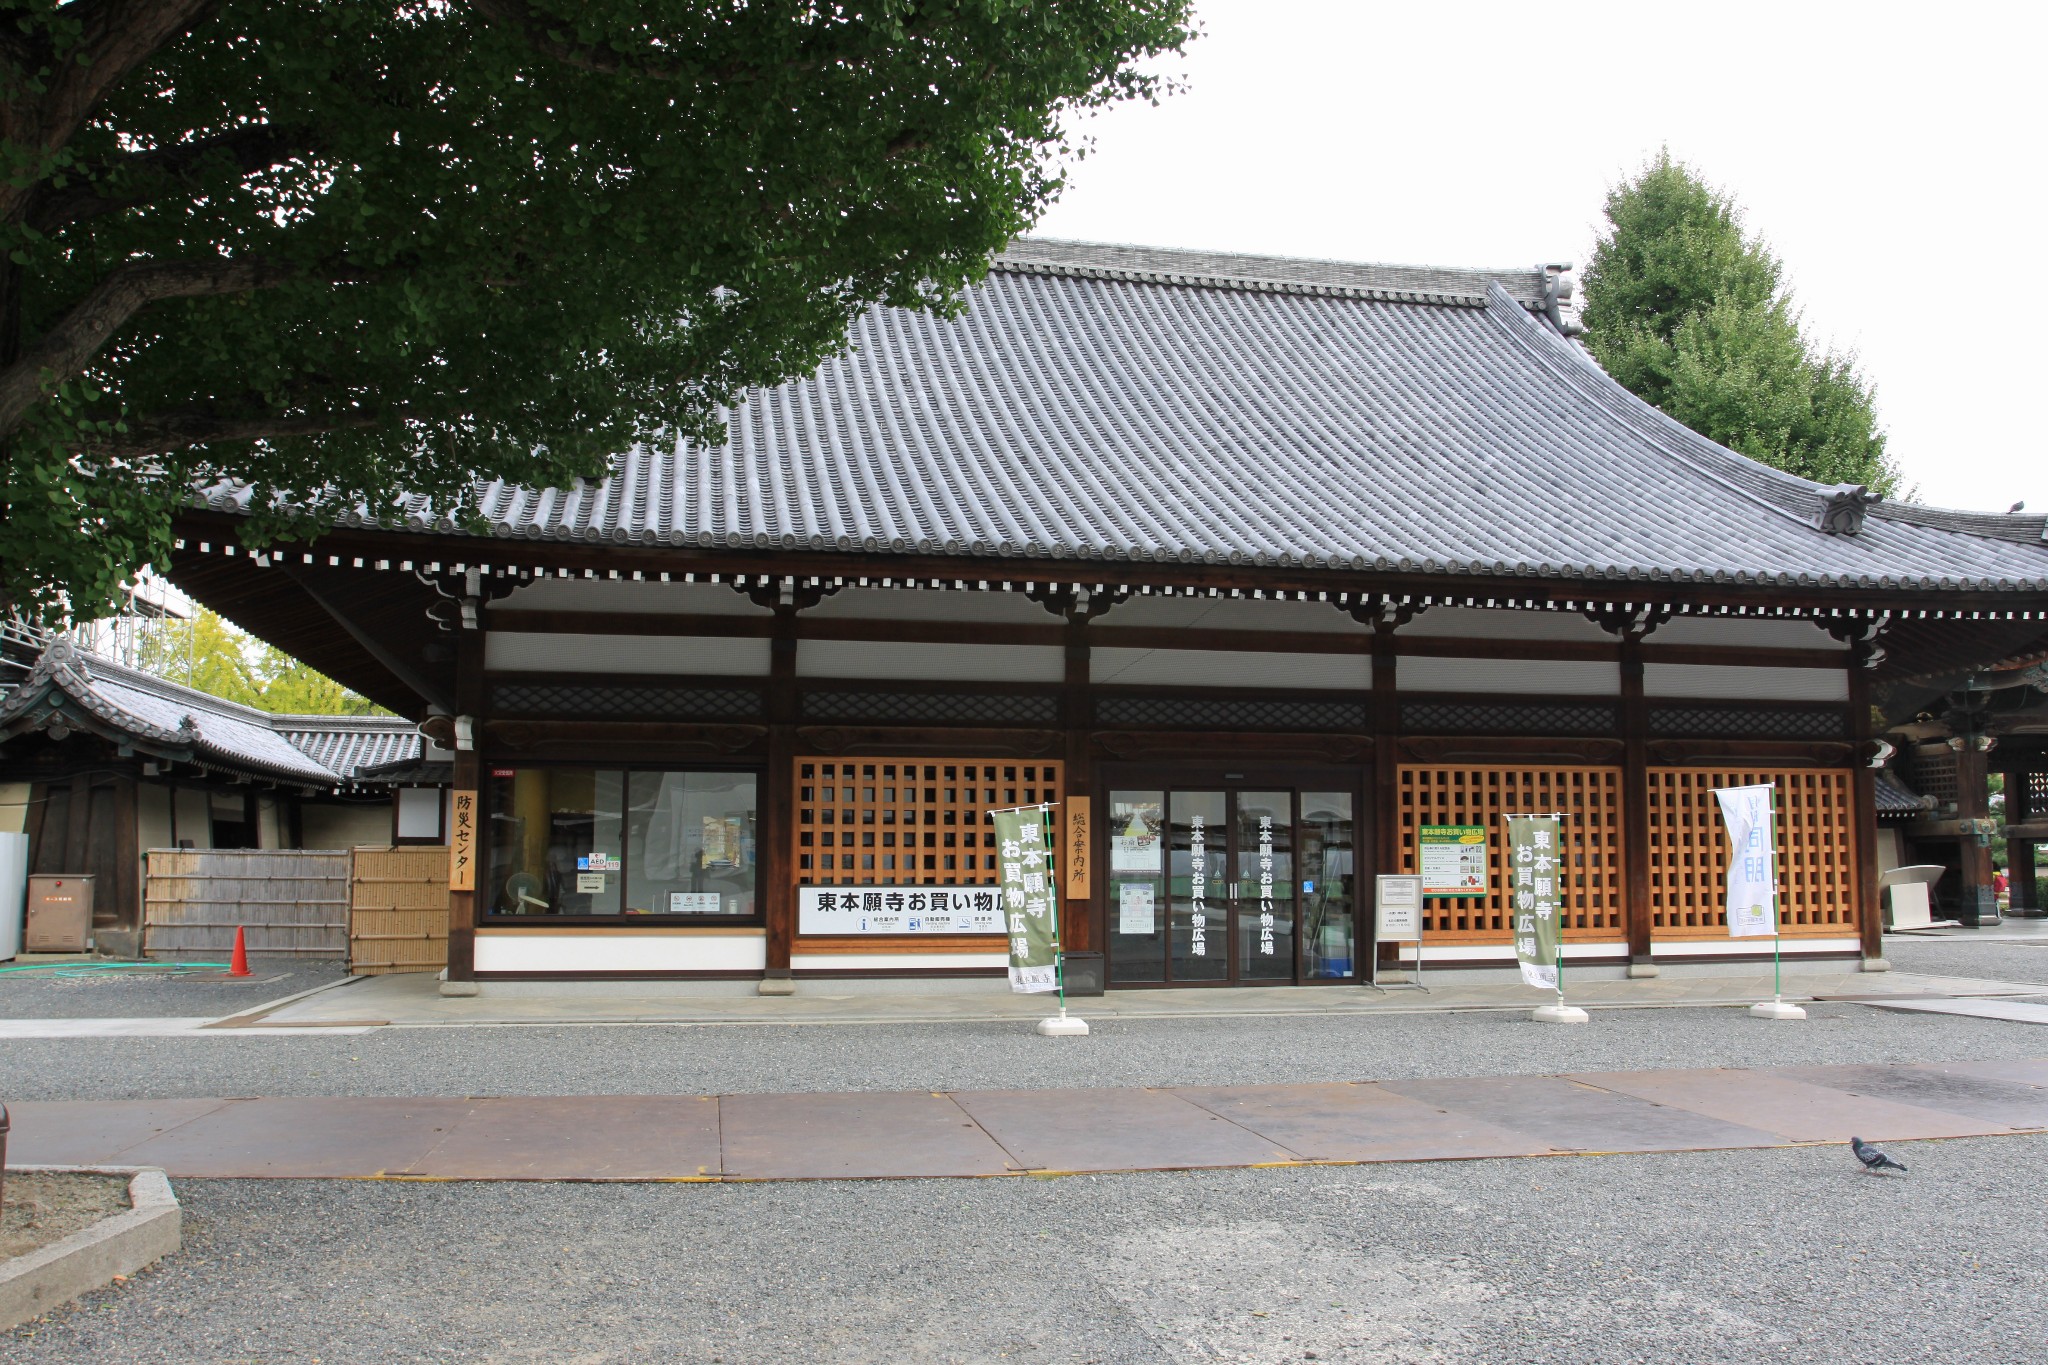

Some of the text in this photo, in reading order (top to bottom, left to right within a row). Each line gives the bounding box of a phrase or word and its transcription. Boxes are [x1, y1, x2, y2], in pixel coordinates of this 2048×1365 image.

[456, 795, 472, 884] 防災センター
[1019, 823, 1047, 919] 東本願寺
[1071, 813, 1086, 883] 総合案内所
[1190, 815, 1206, 956] 東本願寺お買い物広場
[1259, 815, 1274, 955] 東本願寺お買い物広場
[1532, 830, 1553, 920] 東本願寺
[1002, 838, 1029, 959] お買物広場
[1516, 844, 1536, 957] お買物広場
